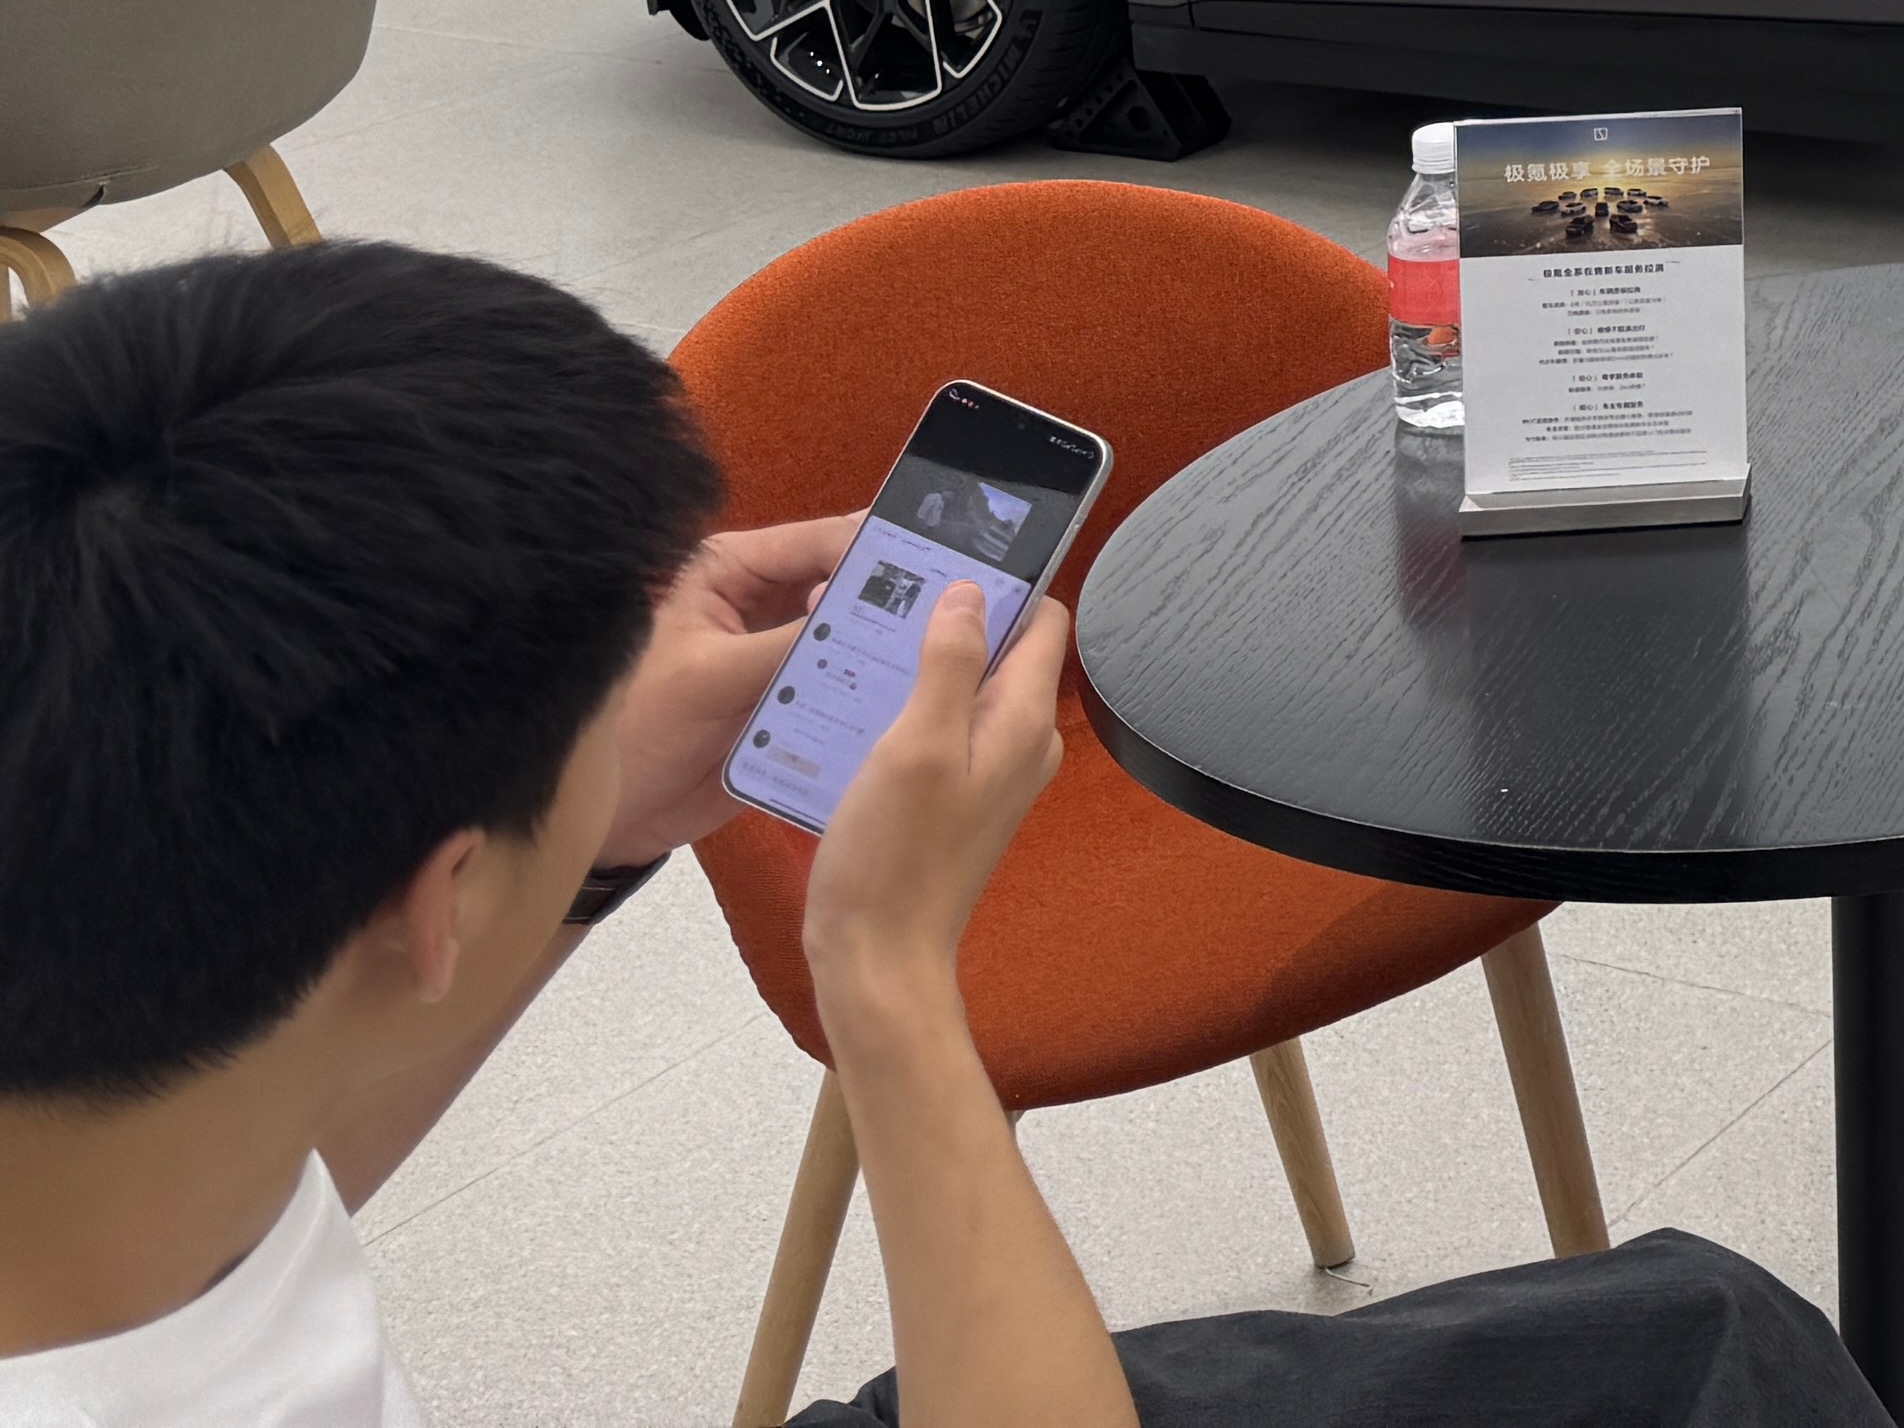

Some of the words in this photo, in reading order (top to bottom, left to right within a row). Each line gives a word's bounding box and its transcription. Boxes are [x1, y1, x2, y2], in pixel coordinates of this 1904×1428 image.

[1504, 160, 1591, 183] 极氪极享
[1603, 155, 1711, 180] 全场景守护
